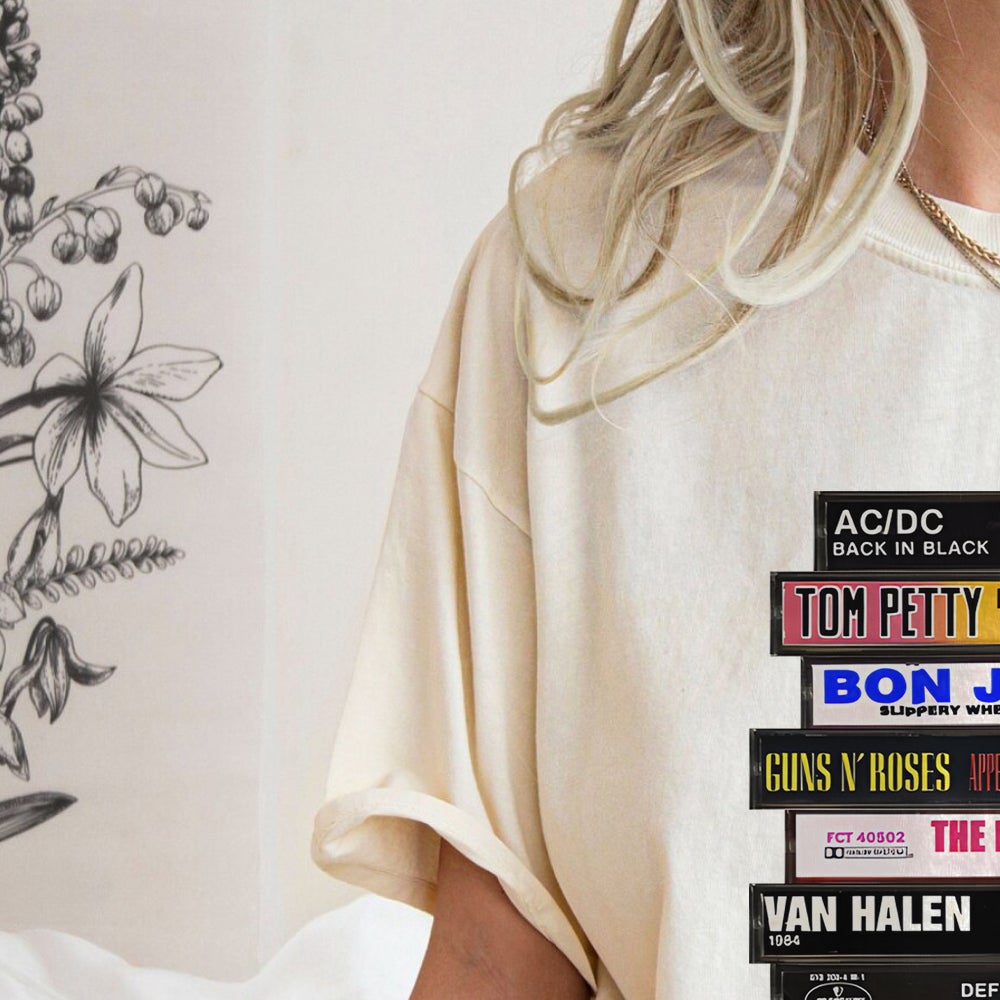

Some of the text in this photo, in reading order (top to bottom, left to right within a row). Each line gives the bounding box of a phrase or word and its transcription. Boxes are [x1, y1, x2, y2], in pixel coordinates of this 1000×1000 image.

[834, 508, 944, 535] AC/DC
[832, 540, 989, 556] BACK IN BLACK
[795, 586, 984, 638] TOM PETTY
[824, 668, 950, 704] BON
[879, 704, 960, 717] SLIPPERY
[765, 752, 832, 792] GUNS
[870, 752, 950, 792] ROSES
[827, 832, 853, 843] FCT
[931, 820, 986, 852] THE
[764, 896, 971, 932] VAN HALEN
[961, 982, 999, 998] DEF
